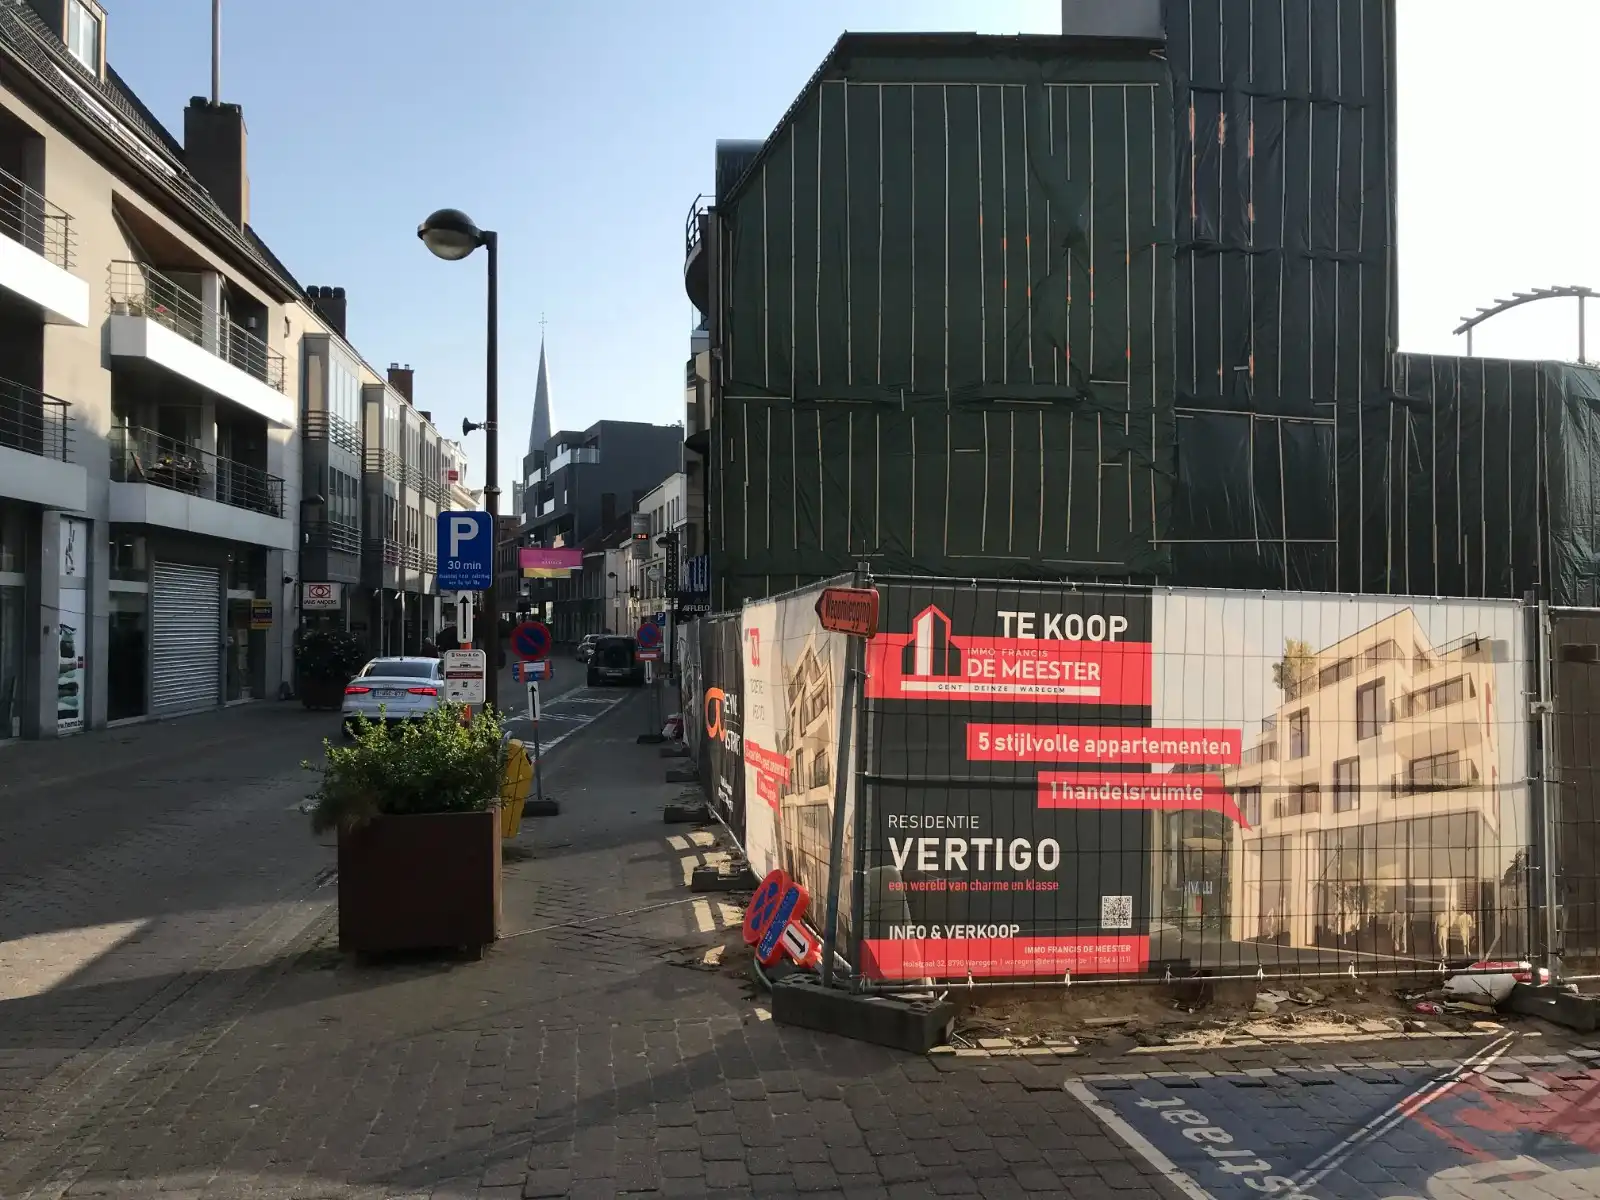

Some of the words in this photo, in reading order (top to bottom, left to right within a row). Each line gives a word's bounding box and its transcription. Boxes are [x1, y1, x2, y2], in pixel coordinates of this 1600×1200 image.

[450, 516, 479, 557] P
[447, 560, 461, 570] 30
[463, 560, 482, 570] min
[997, 611, 1036, 640] TE
[1044, 613, 1129, 642] KOOP
[967, 647, 996, 656] IMMO
[1001, 648, 1049, 658] FRANCIS
[967, 659, 996, 678] DE
[1002, 660, 1101, 682] MEESTER
[937, 683, 963, 691] GENT
[974, 684, 1008, 692] DEINZE
[1019, 686, 1067, 694] WAREGEM
[978, 732, 990, 751] 5
[994, 733, 1080, 758] stijlvolle
[1084, 737, 1232, 762] appartementen
[1051, 781, 1058, 800] 1
[1061, 781, 1204, 802] handelsruimte
[888, 814, 980, 830] RESIDENTIE
[888, 837, 1061, 872] VERTIGO
[888, 880, 907, 891] een
[909, 879, 947, 892] wereld
[948, 881, 968, 891] van
[970, 879, 1009, 891] charme
[1011, 882, 1024, 891] en
[1025, 879, 1059, 891] klasse
[889, 925, 926, 941] INFO
[930, 924, 942, 940] &
[944, 923, 1020, 940] VERKOOP
[1024, 946, 1046, 954] IMMO
[1047, 945, 1082, 954] FRANCIS
[1083, 945, 1094, 953] DE
[1095, 944, 1132, 953] MEESTER
[1134, 1096, 1321, 1200] straat
